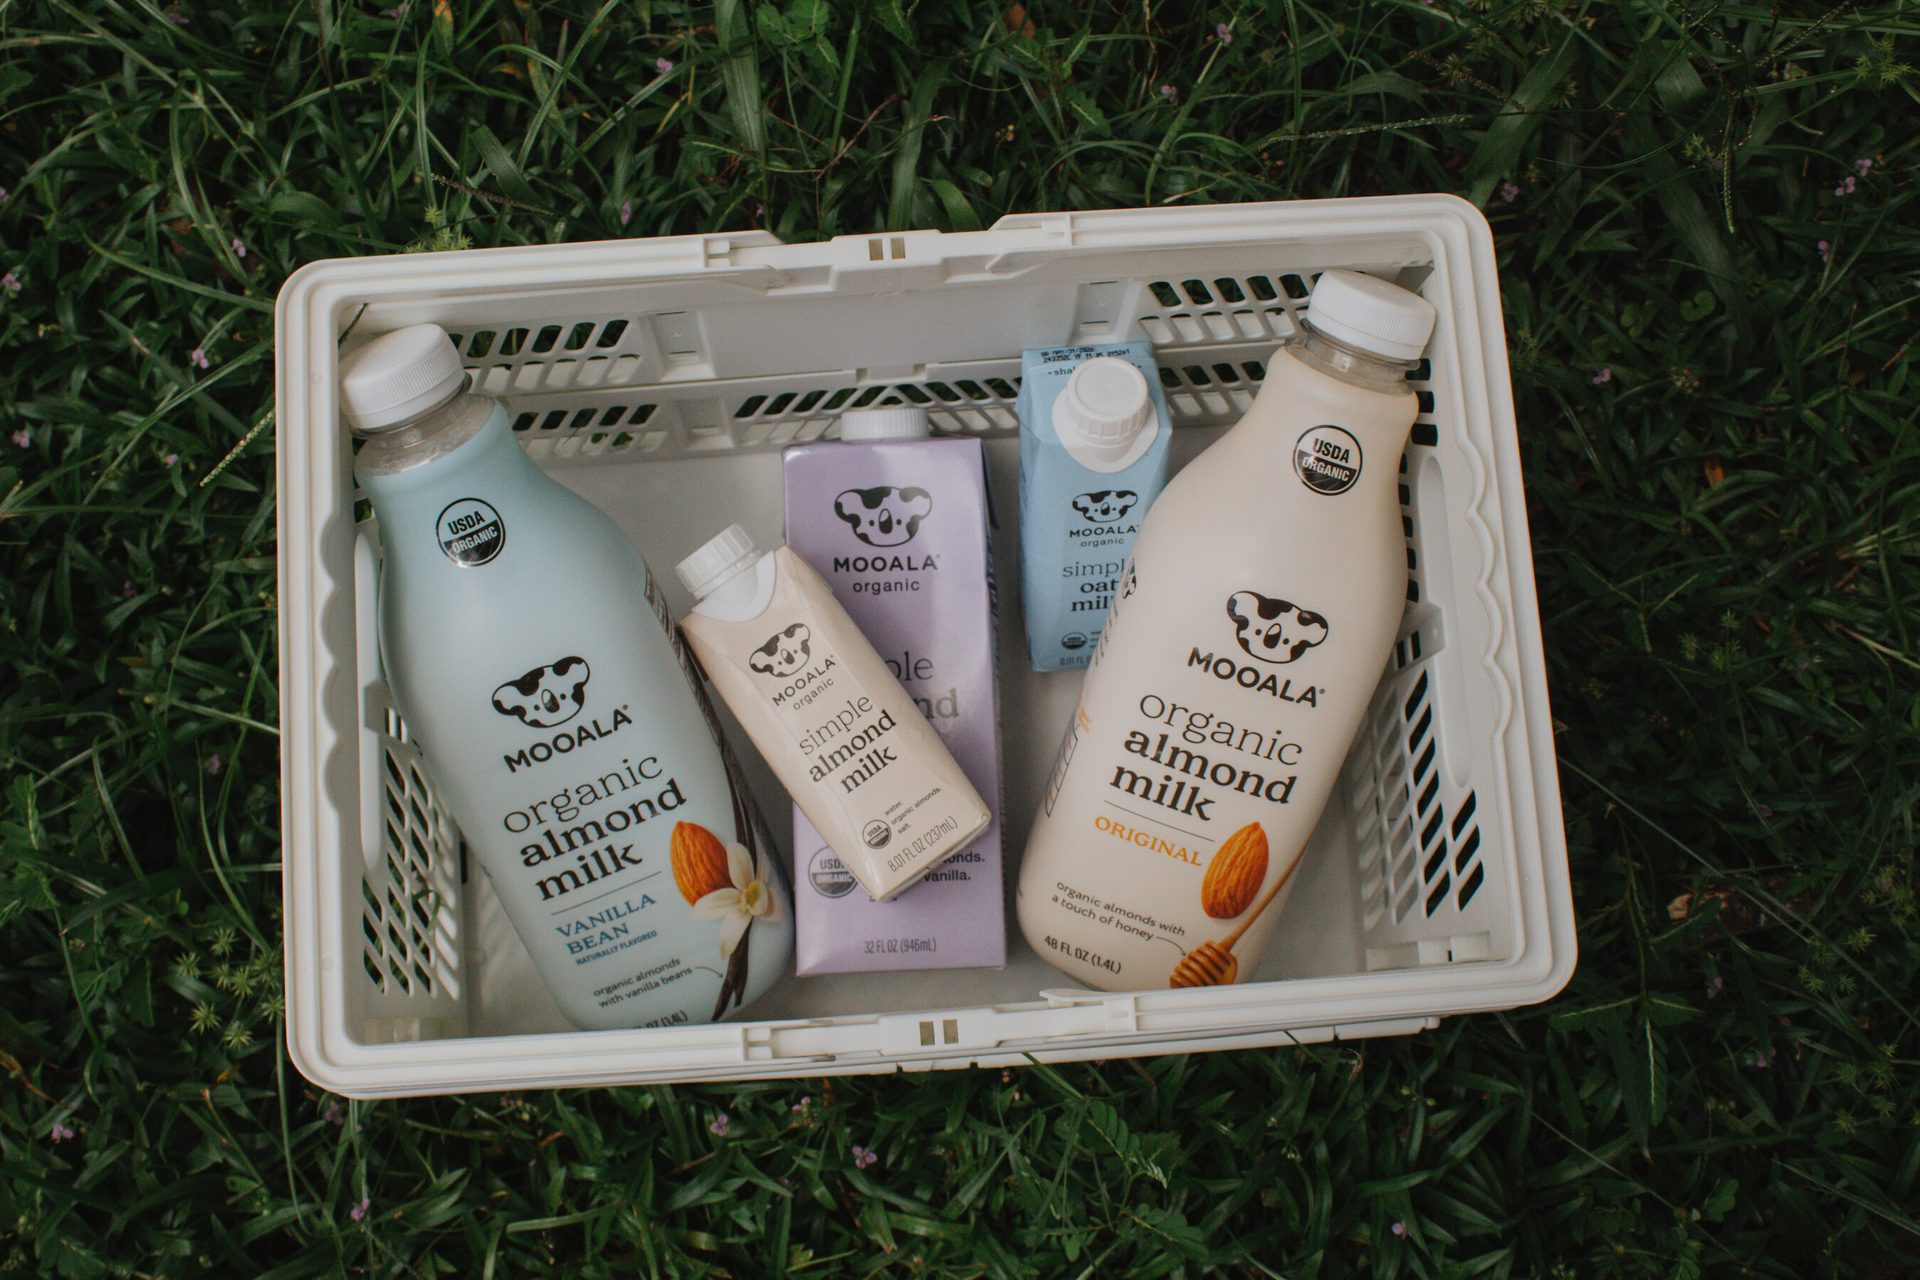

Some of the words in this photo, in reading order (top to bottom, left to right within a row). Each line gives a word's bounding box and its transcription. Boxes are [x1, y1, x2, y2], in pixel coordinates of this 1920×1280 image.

[1054, 366, 1077, 376] sha
[1302, 455, 1351, 483] ORGANIC
[1312, 437, 1350, 464] USDA
[447, 510, 486, 535] USDA
[451, 526, 498, 554] ORGANIC
[1069, 525, 1137, 539] MOOALA
[833, 554, 938, 573] MOOALA
[1080, 538, 1125, 549] organic
[852, 578, 920, 596] organic
[1062, 558, 1126, 579] simpl
[1080, 578, 1119, 594] oat
[1070, 595, 1113, 612] mil
[771, 656, 837, 708] MOOALA
[792, 677, 835, 712] organic
[1187, 646, 1318, 708] MOOALA
[503, 708, 633, 774] MOOALA
[799, 695, 874, 757] simple
[1139, 694, 1303, 767] organic
[808, 709, 898, 784] almond
[840, 746, 898, 795] milk
[1123, 730, 1298, 805] almond
[503, 755, 664, 834] organic
[1109, 764, 1216, 822] milk
[519, 777, 688, 868] almond
[890, 807, 914, 826] organic
[887, 850, 906, 874] 8.01
[903, 844, 917, 862] FL
[913, 838, 927, 854] OZ
[923, 815, 959, 848] (237mL)
[943, 851, 985, 864] onds.
[1094, 815, 1203, 868] ORIGINAL
[534, 839, 644, 902] milk
[924, 869, 972, 883] vanilla.
[555, 894, 657, 938] VANILLA
[1052, 894, 1059, 903] a
[1061, 898, 1097, 920] touch
[1099, 915, 1114, 926] of
[1115, 919, 1155, 942] honey
[1056, 881, 1102, 908] organic
[1103, 902, 1156, 927] almonds
[1159, 921, 1186, 937] with
[566, 923, 630, 955] BEAN
[575, 946, 619, 967] NATURALLY
[620, 930, 658, 951] FLAVORED
[864, 940, 876, 955] 32
[876, 940, 886, 953] FL
[887, 939, 898, 953] OZ
[900, 936, 937, 955] (946mL)
[1044, 935, 1058, 950] 48
[1060, 941, 1073, 957] FL
[1074, 947, 1090, 963] OZ
[1091, 954, 1123, 975] (1.4L)
[592, 976, 634, 998] organic
[635, 958, 682, 983] almonds
[598, 993, 625, 1009] with
[625, 979, 661, 1000] vanilla
[661, 965, 693, 986] beans
